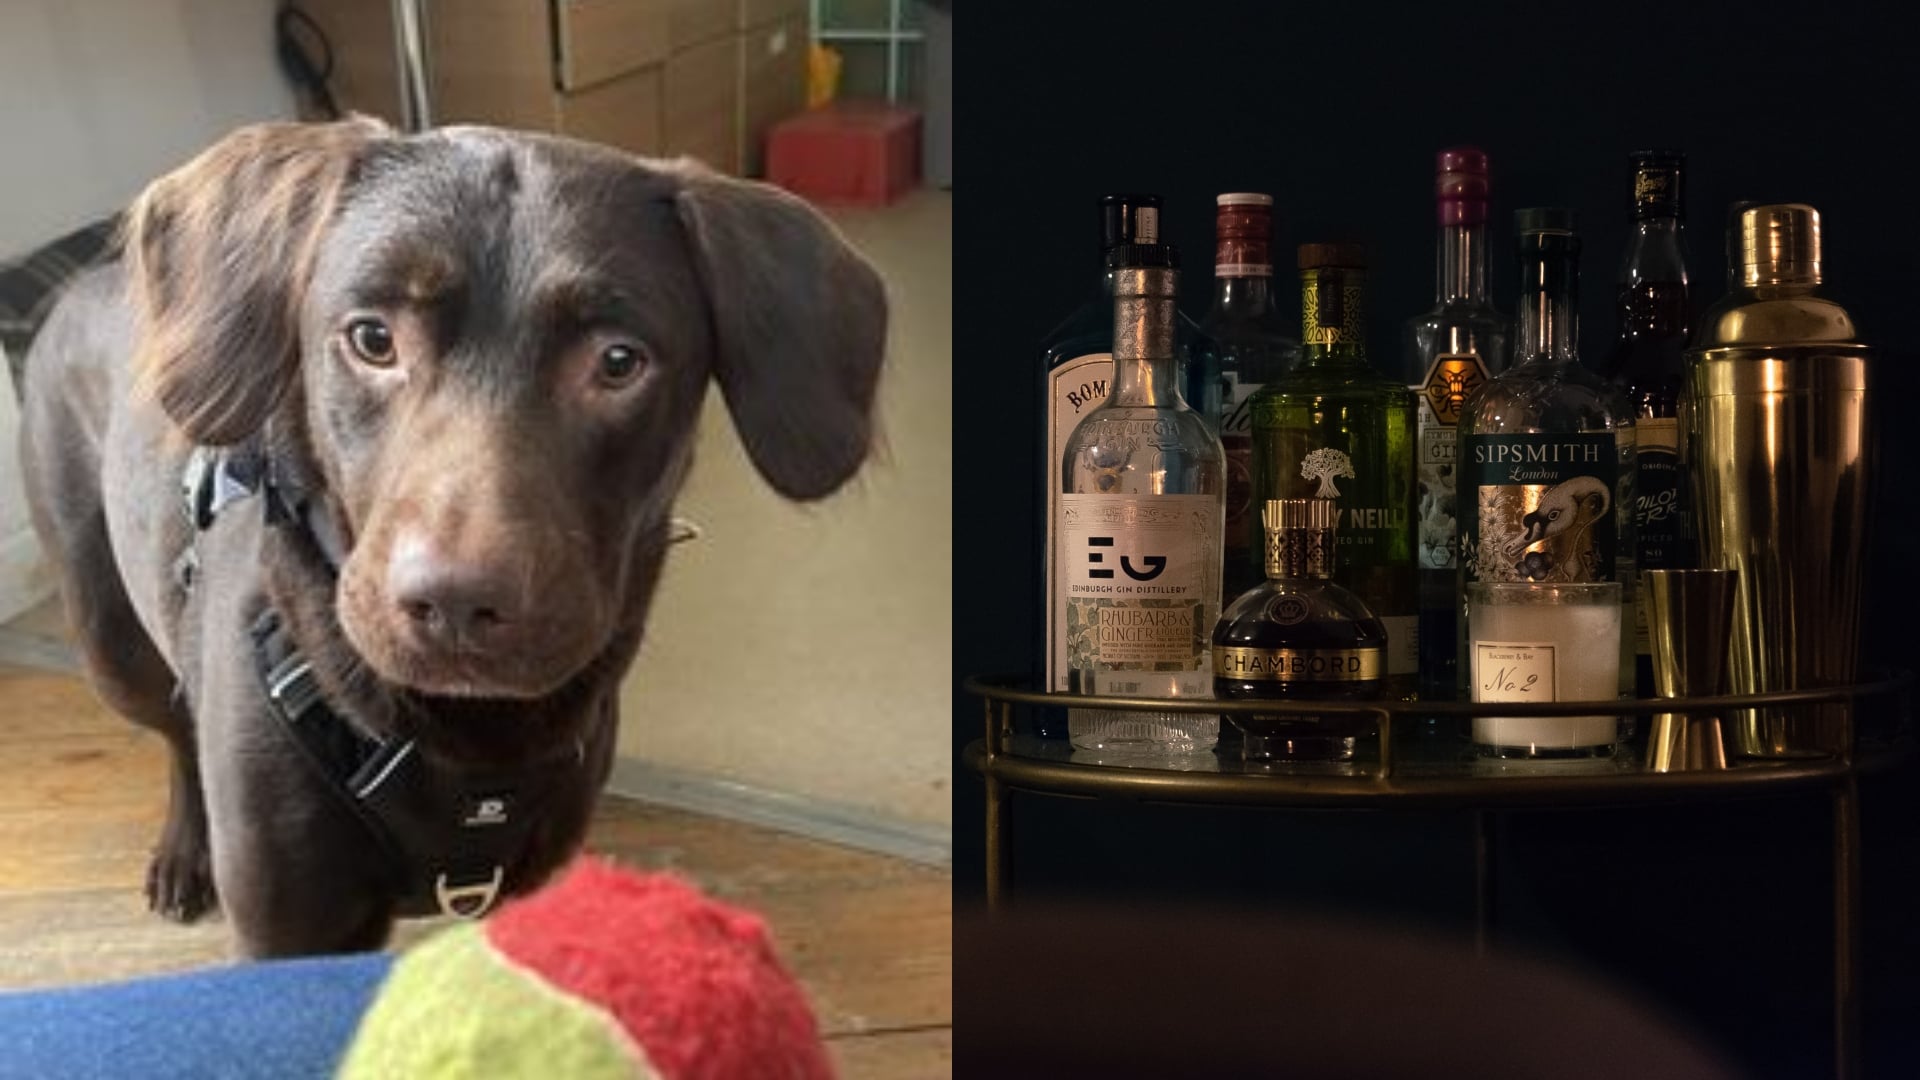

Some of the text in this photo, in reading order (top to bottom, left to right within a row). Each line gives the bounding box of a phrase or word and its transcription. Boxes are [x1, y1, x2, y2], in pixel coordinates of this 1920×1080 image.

[1067, 380, 1111, 413] BOM
[1475, 443, 1599, 463] SIPSMITH
[1508, 466, 1559, 481] London
[1641, 463, 1677, 471] ORIGINA
[1088, 537, 1167, 581] EG
[1072, 584, 1187, 594] EDINBURGH GIN DISTILLERY
[1101, 610, 1191, 628] RHUBARB &
[1101, 626, 1154, 641] GINGER
[1224, 655, 1361, 673] CHAMBORD
[1520, 674, 1538, 692] 2
